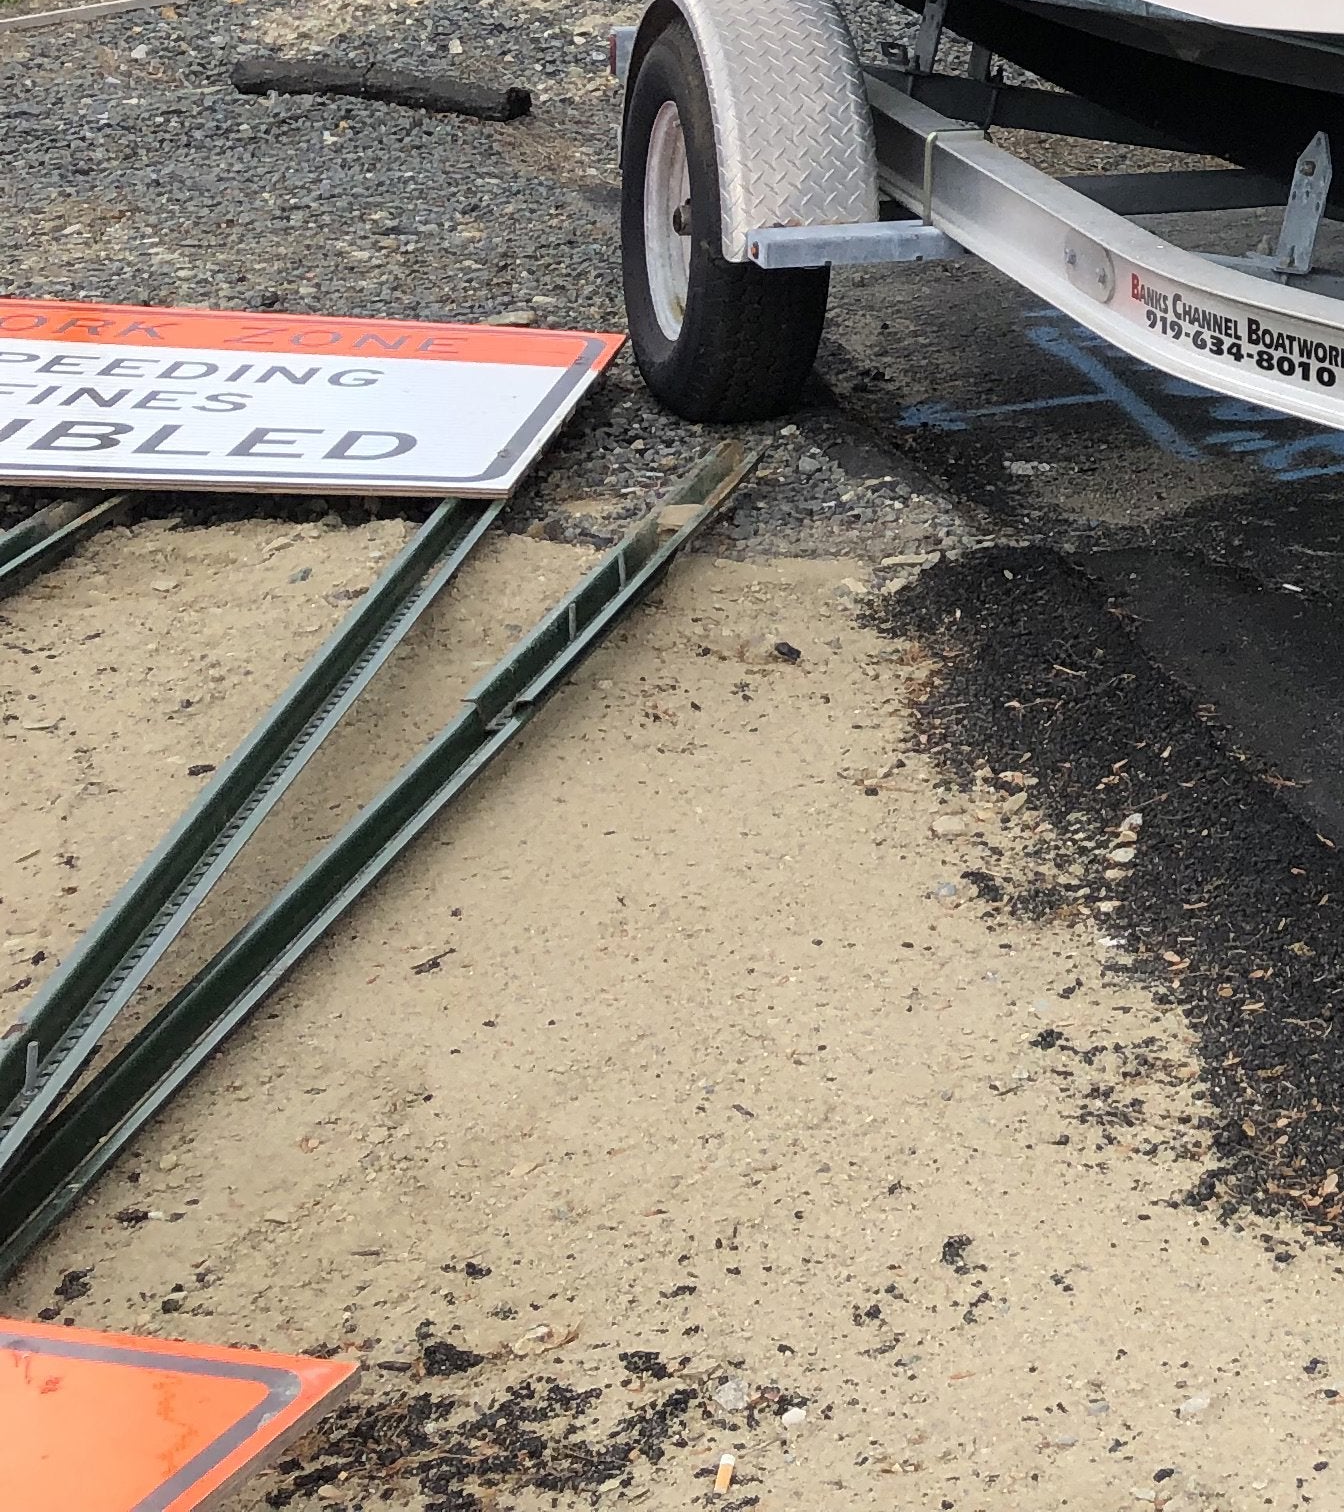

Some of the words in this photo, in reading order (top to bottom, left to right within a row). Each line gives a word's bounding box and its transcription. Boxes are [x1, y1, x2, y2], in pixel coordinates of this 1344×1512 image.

[224, 326, 471, 354] ZONE
[1131, 272, 1169, 315] BANKS
[1172, 292, 1242, 341] CHANNEL
[1146, 309, 1337, 387] 919-634-8010
